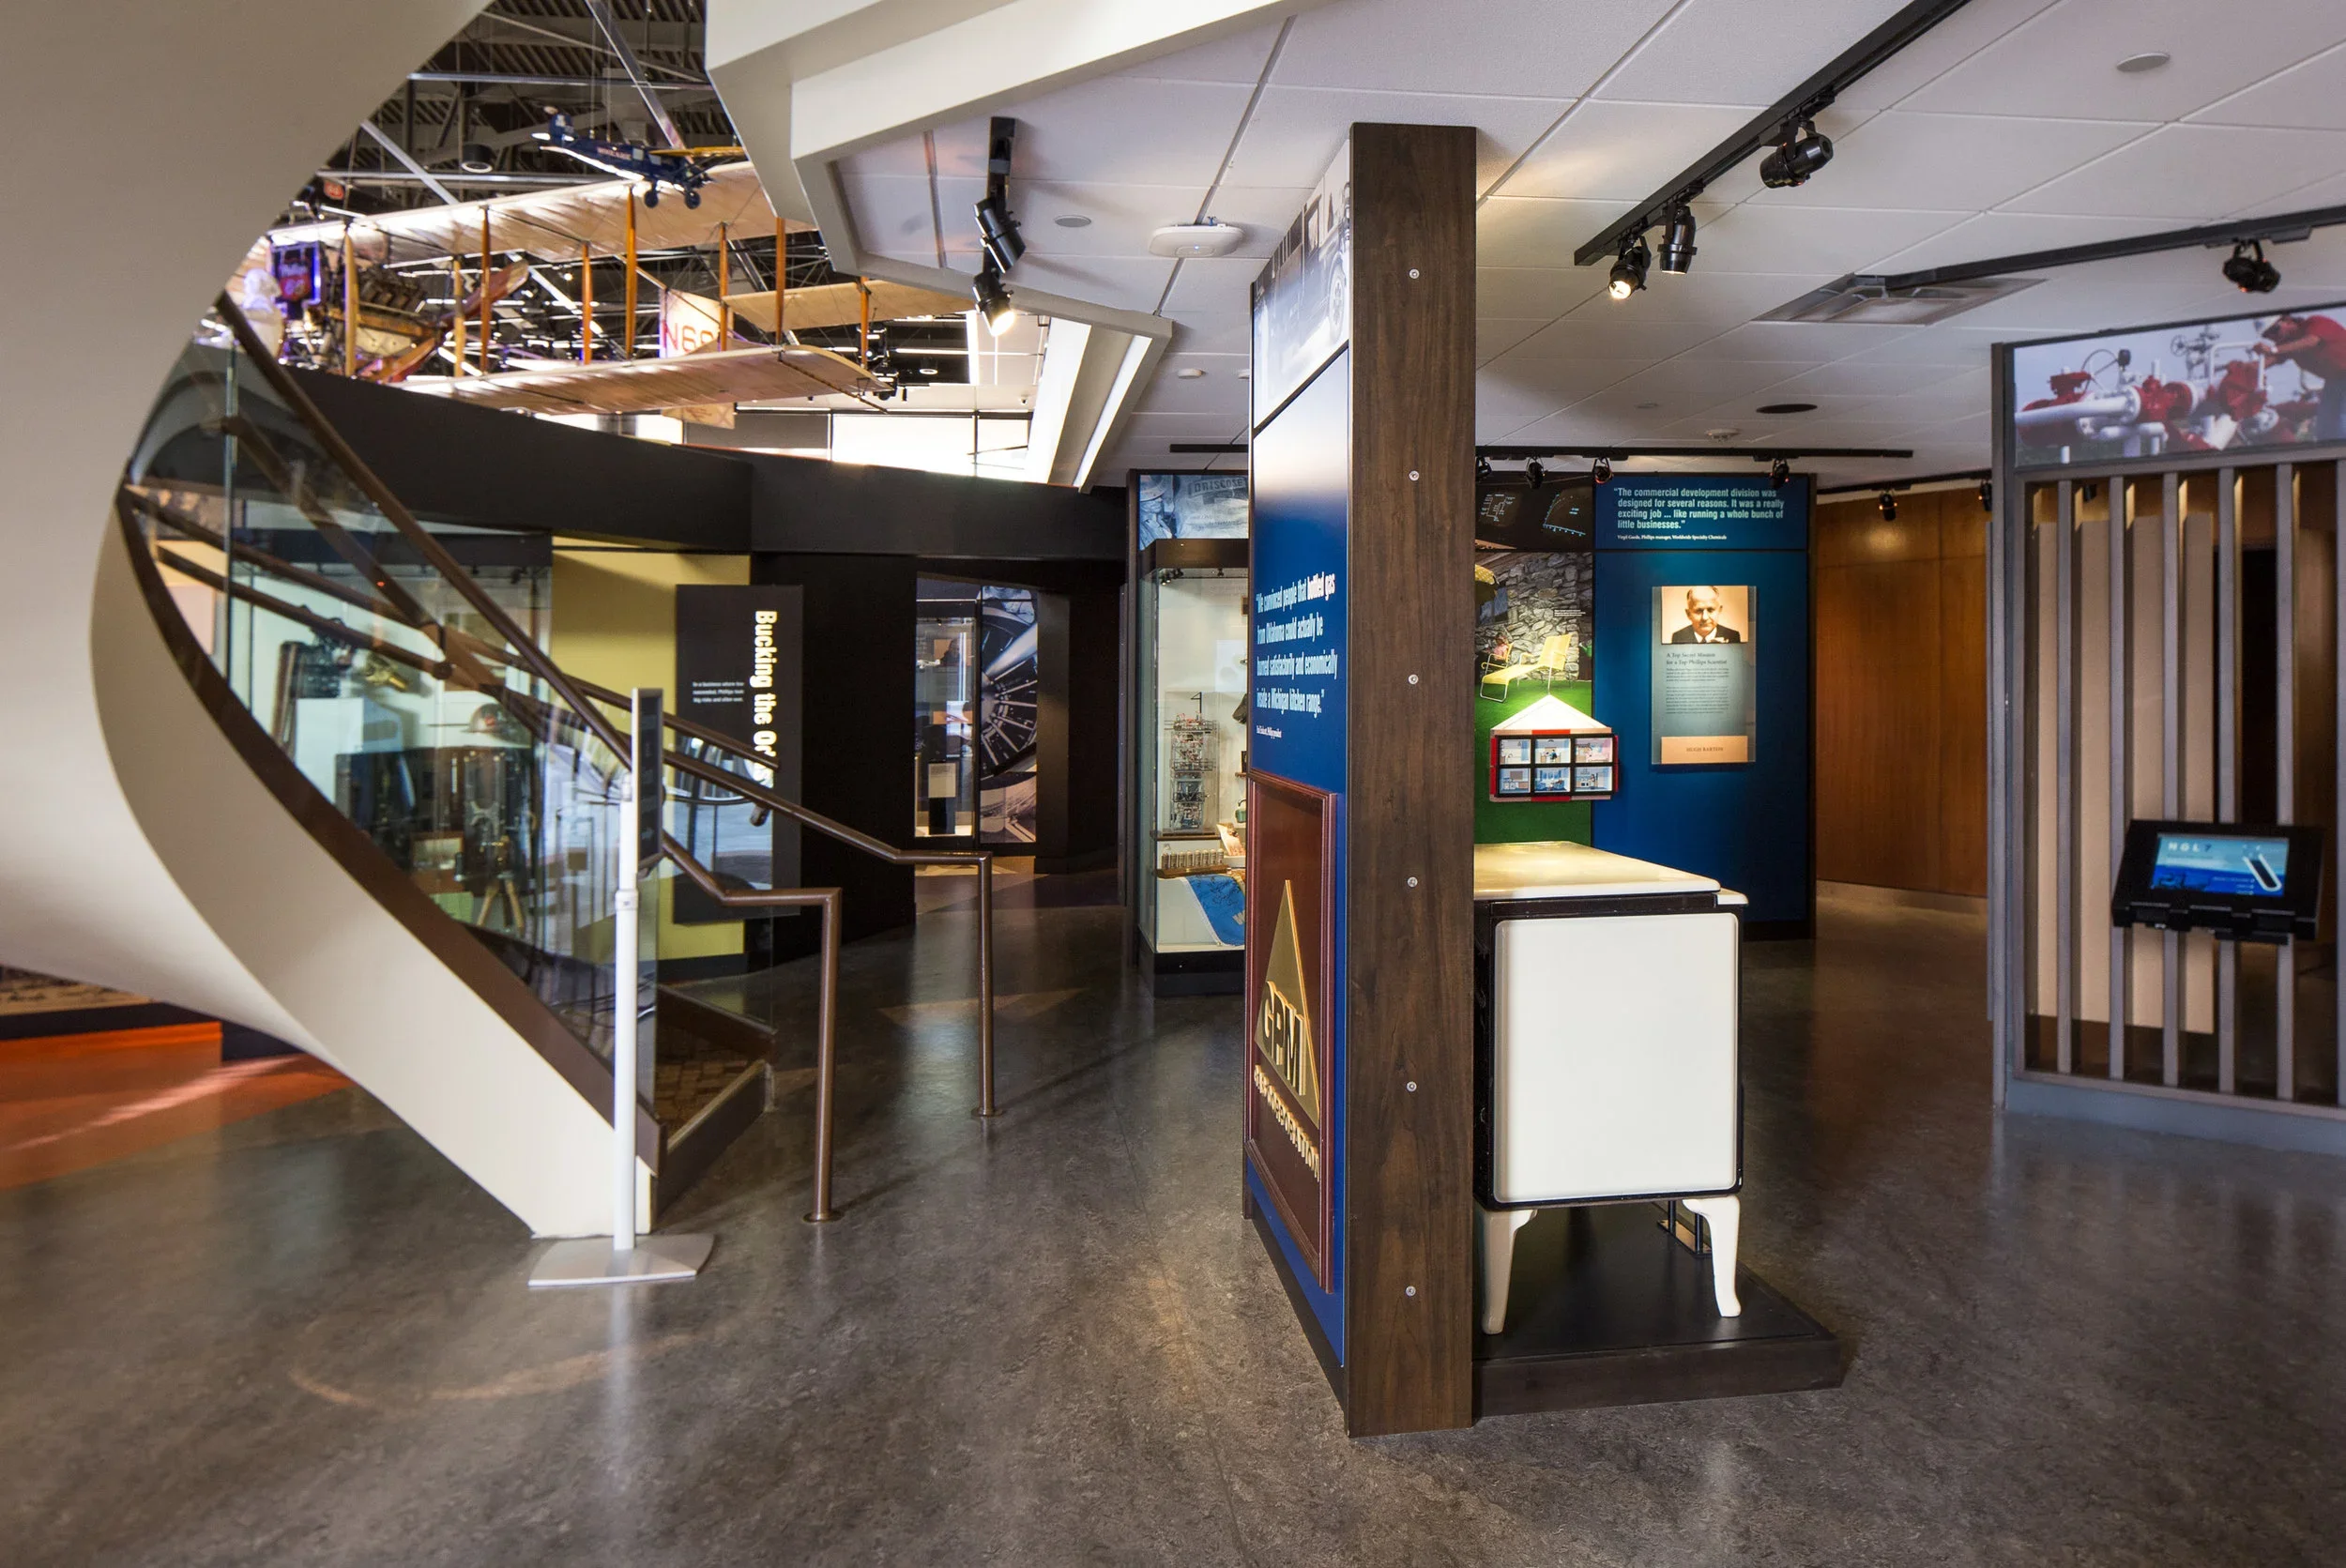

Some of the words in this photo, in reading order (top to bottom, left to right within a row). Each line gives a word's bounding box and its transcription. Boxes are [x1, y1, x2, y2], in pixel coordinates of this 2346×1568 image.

[1618, 498, 1653, 509] designed
[1654, 498, 1666, 508] for
[1667, 498, 1695, 508] several
[1697, 499, 1729, 508] reasons.
[1730, 499, 1737, 508] It
[1762, 499, 1785, 510] really
[1634, 488, 1679, 497] commercial
[1681, 488, 1729, 498] development
[1730, 488, 1760, 497] division
[1618, 509, 1648, 520] exciting
[1650, 509, 1662, 520] job
[1673, 509, 1687, 518] like
[1689, 510, 1718, 520] running
[1727, 510, 1749, 518] whole
[1751, 510, 1774, 518] bunch
[1775, 510, 1784, 518] of
[1618, 520, 1635, 529] little
[1283, 582, 1297, 612] people
[1297, 578, 1306, 602] that
[1306, 571, 1325, 601] bottled
[1325, 572, 1335, 601] gas
[1297, 613, 1316, 642] actually
[1316, 612, 1323, 636] be
[750, 610, 778, 689] Bucking
[1295, 651, 1304, 676] and
[1304, 648, 1338, 680] economically
[754, 693, 777, 725] the
[1262, 982, 1306, 1096] GPM
[1267, 1085, 1320, 1182] CORPORATION
